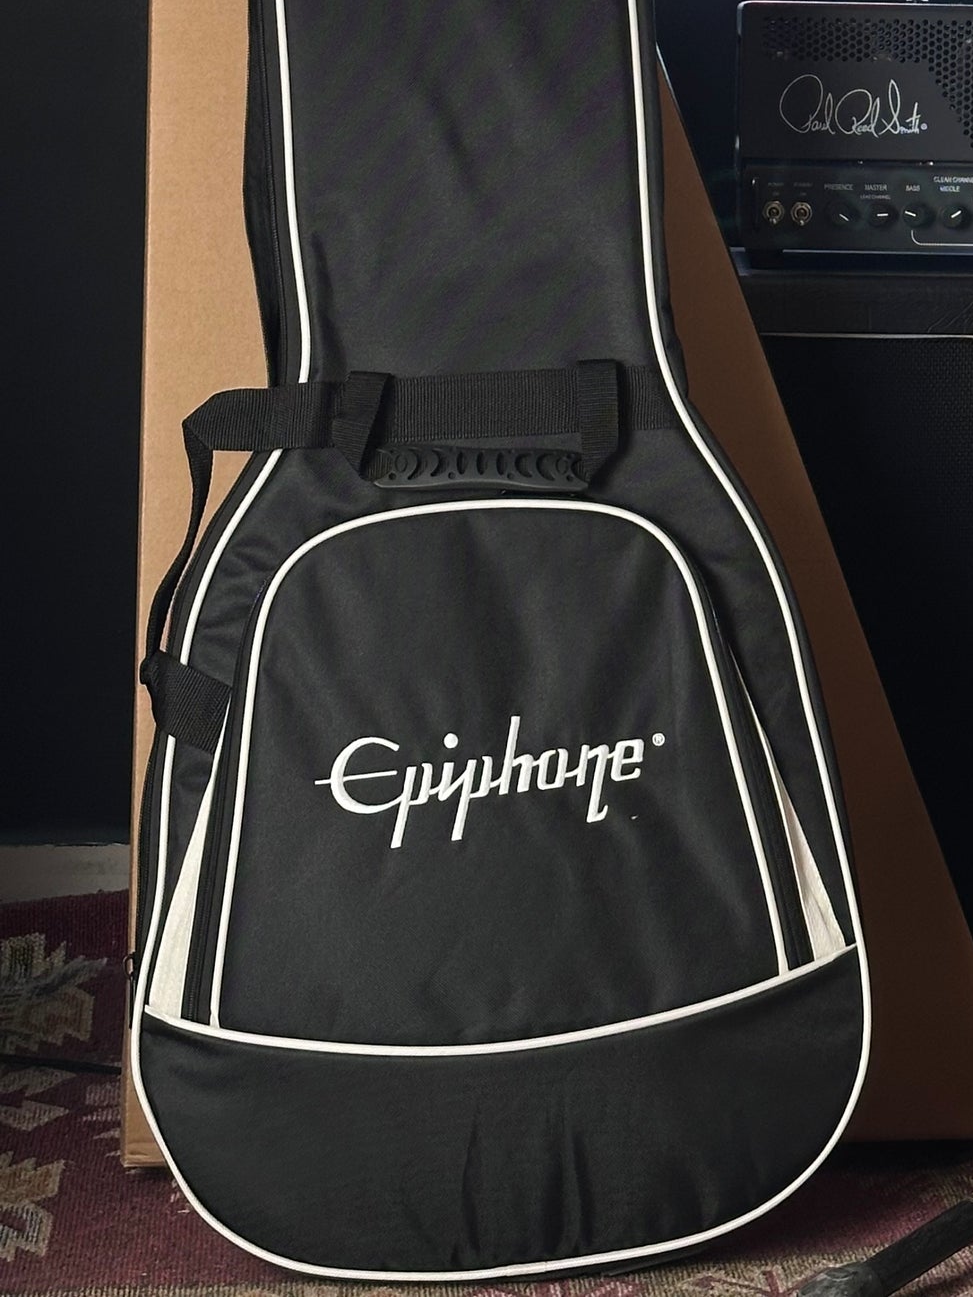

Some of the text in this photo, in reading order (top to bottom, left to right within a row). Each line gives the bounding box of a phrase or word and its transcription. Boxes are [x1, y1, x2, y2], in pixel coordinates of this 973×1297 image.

[779, 73, 922, 139] Paul Reed Smith
